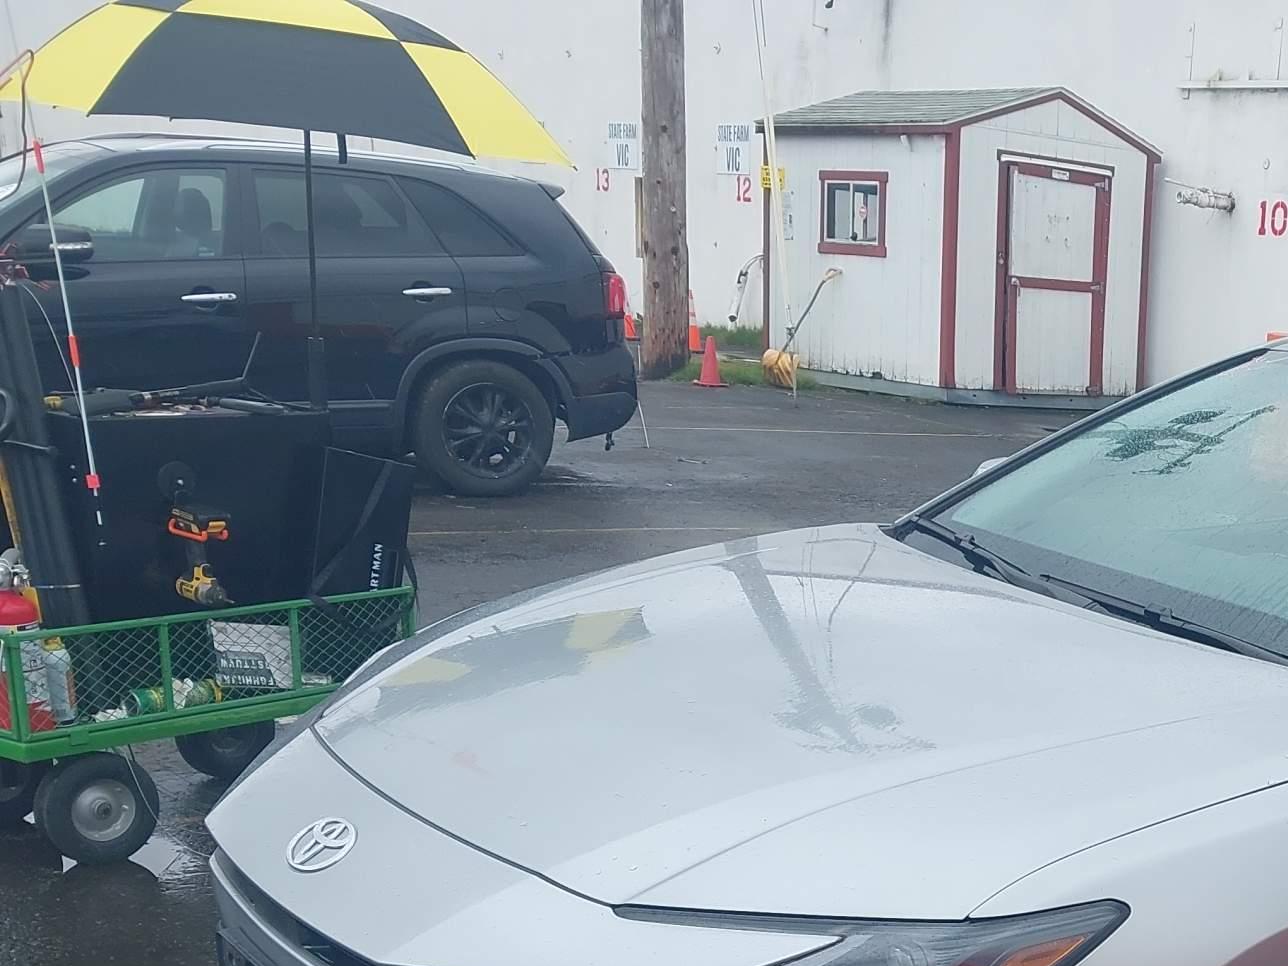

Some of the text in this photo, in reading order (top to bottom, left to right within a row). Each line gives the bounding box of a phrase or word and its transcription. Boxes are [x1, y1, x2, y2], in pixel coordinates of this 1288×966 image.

[608, 123, 637, 139] STATE FARM
[717, 124, 750, 142] STATE FARM
[616, 143, 629, 167] VIC
[726, 147, 741, 172] VIC
[596, 167, 610, 192] 13
[736, 174, 752, 203] 12
[1258, 200, 1288, 236] 10
